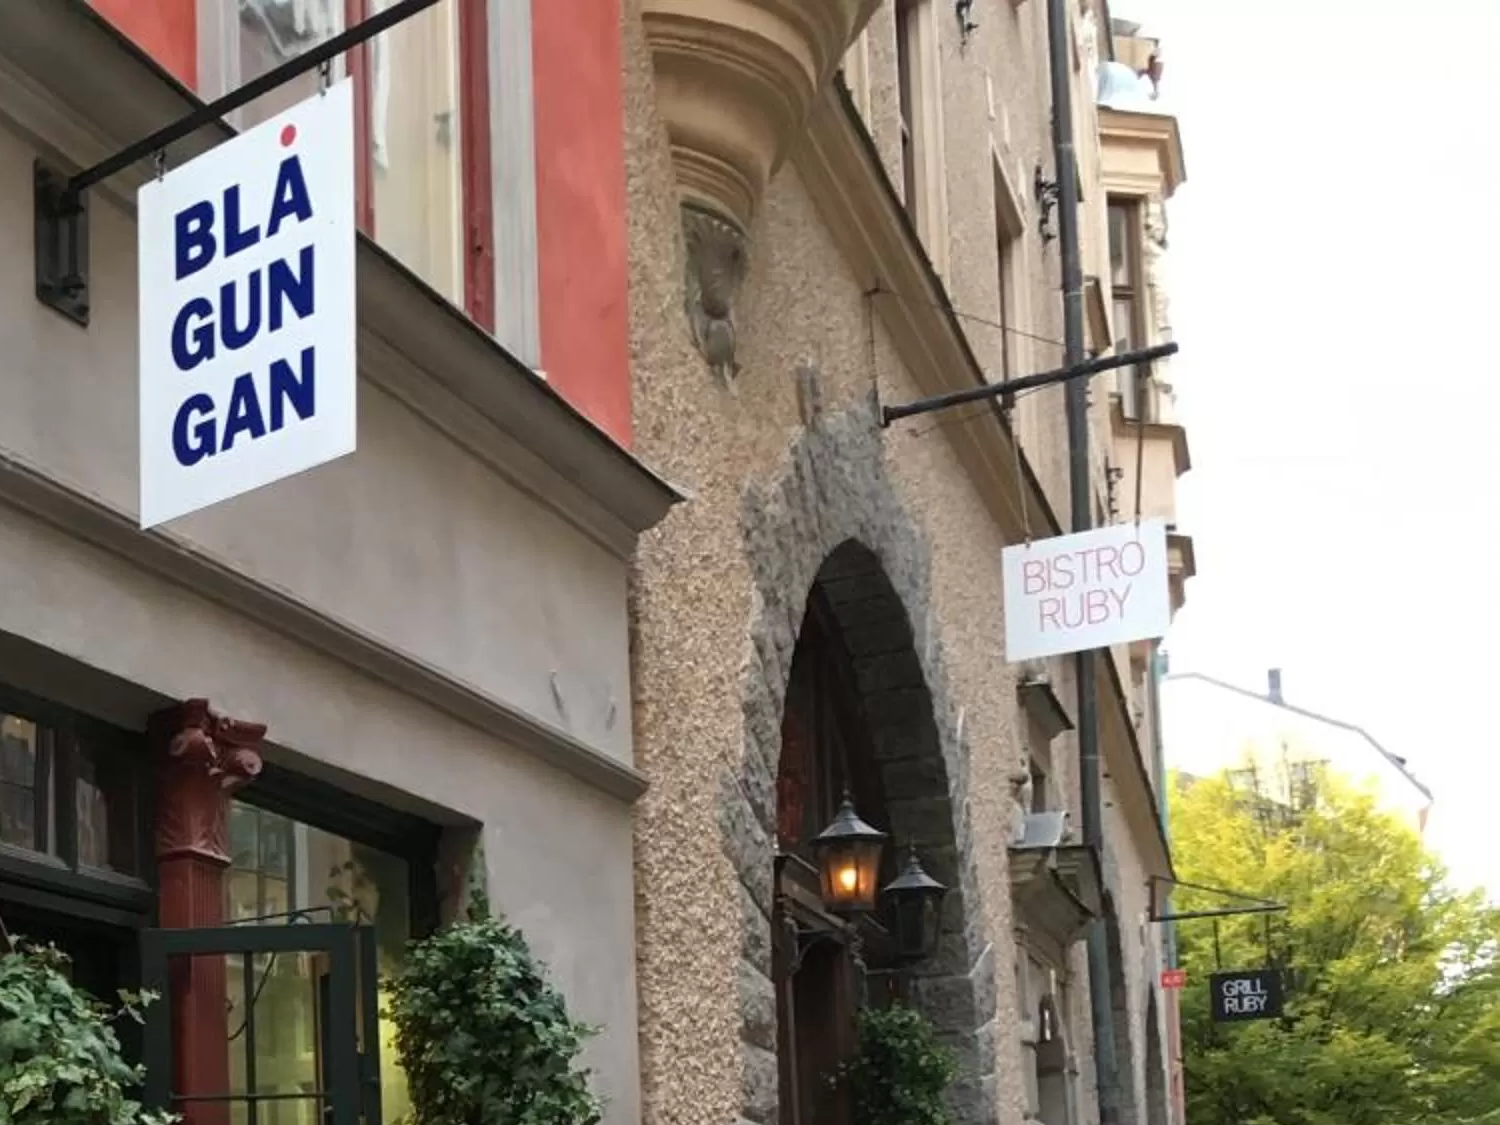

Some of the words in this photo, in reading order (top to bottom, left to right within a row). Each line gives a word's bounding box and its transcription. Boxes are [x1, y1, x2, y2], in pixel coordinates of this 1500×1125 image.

[175, 124, 313, 280] BLÅ
[171, 244, 315, 371] GUN
[171, 346, 315, 466] GAN
[1022, 541, 1146, 595] BISTRO
[1039, 583, 1132, 632] RUBY
[1223, 978, 1268, 996] GRILL
[1224, 995, 1267, 1013] RUBY
